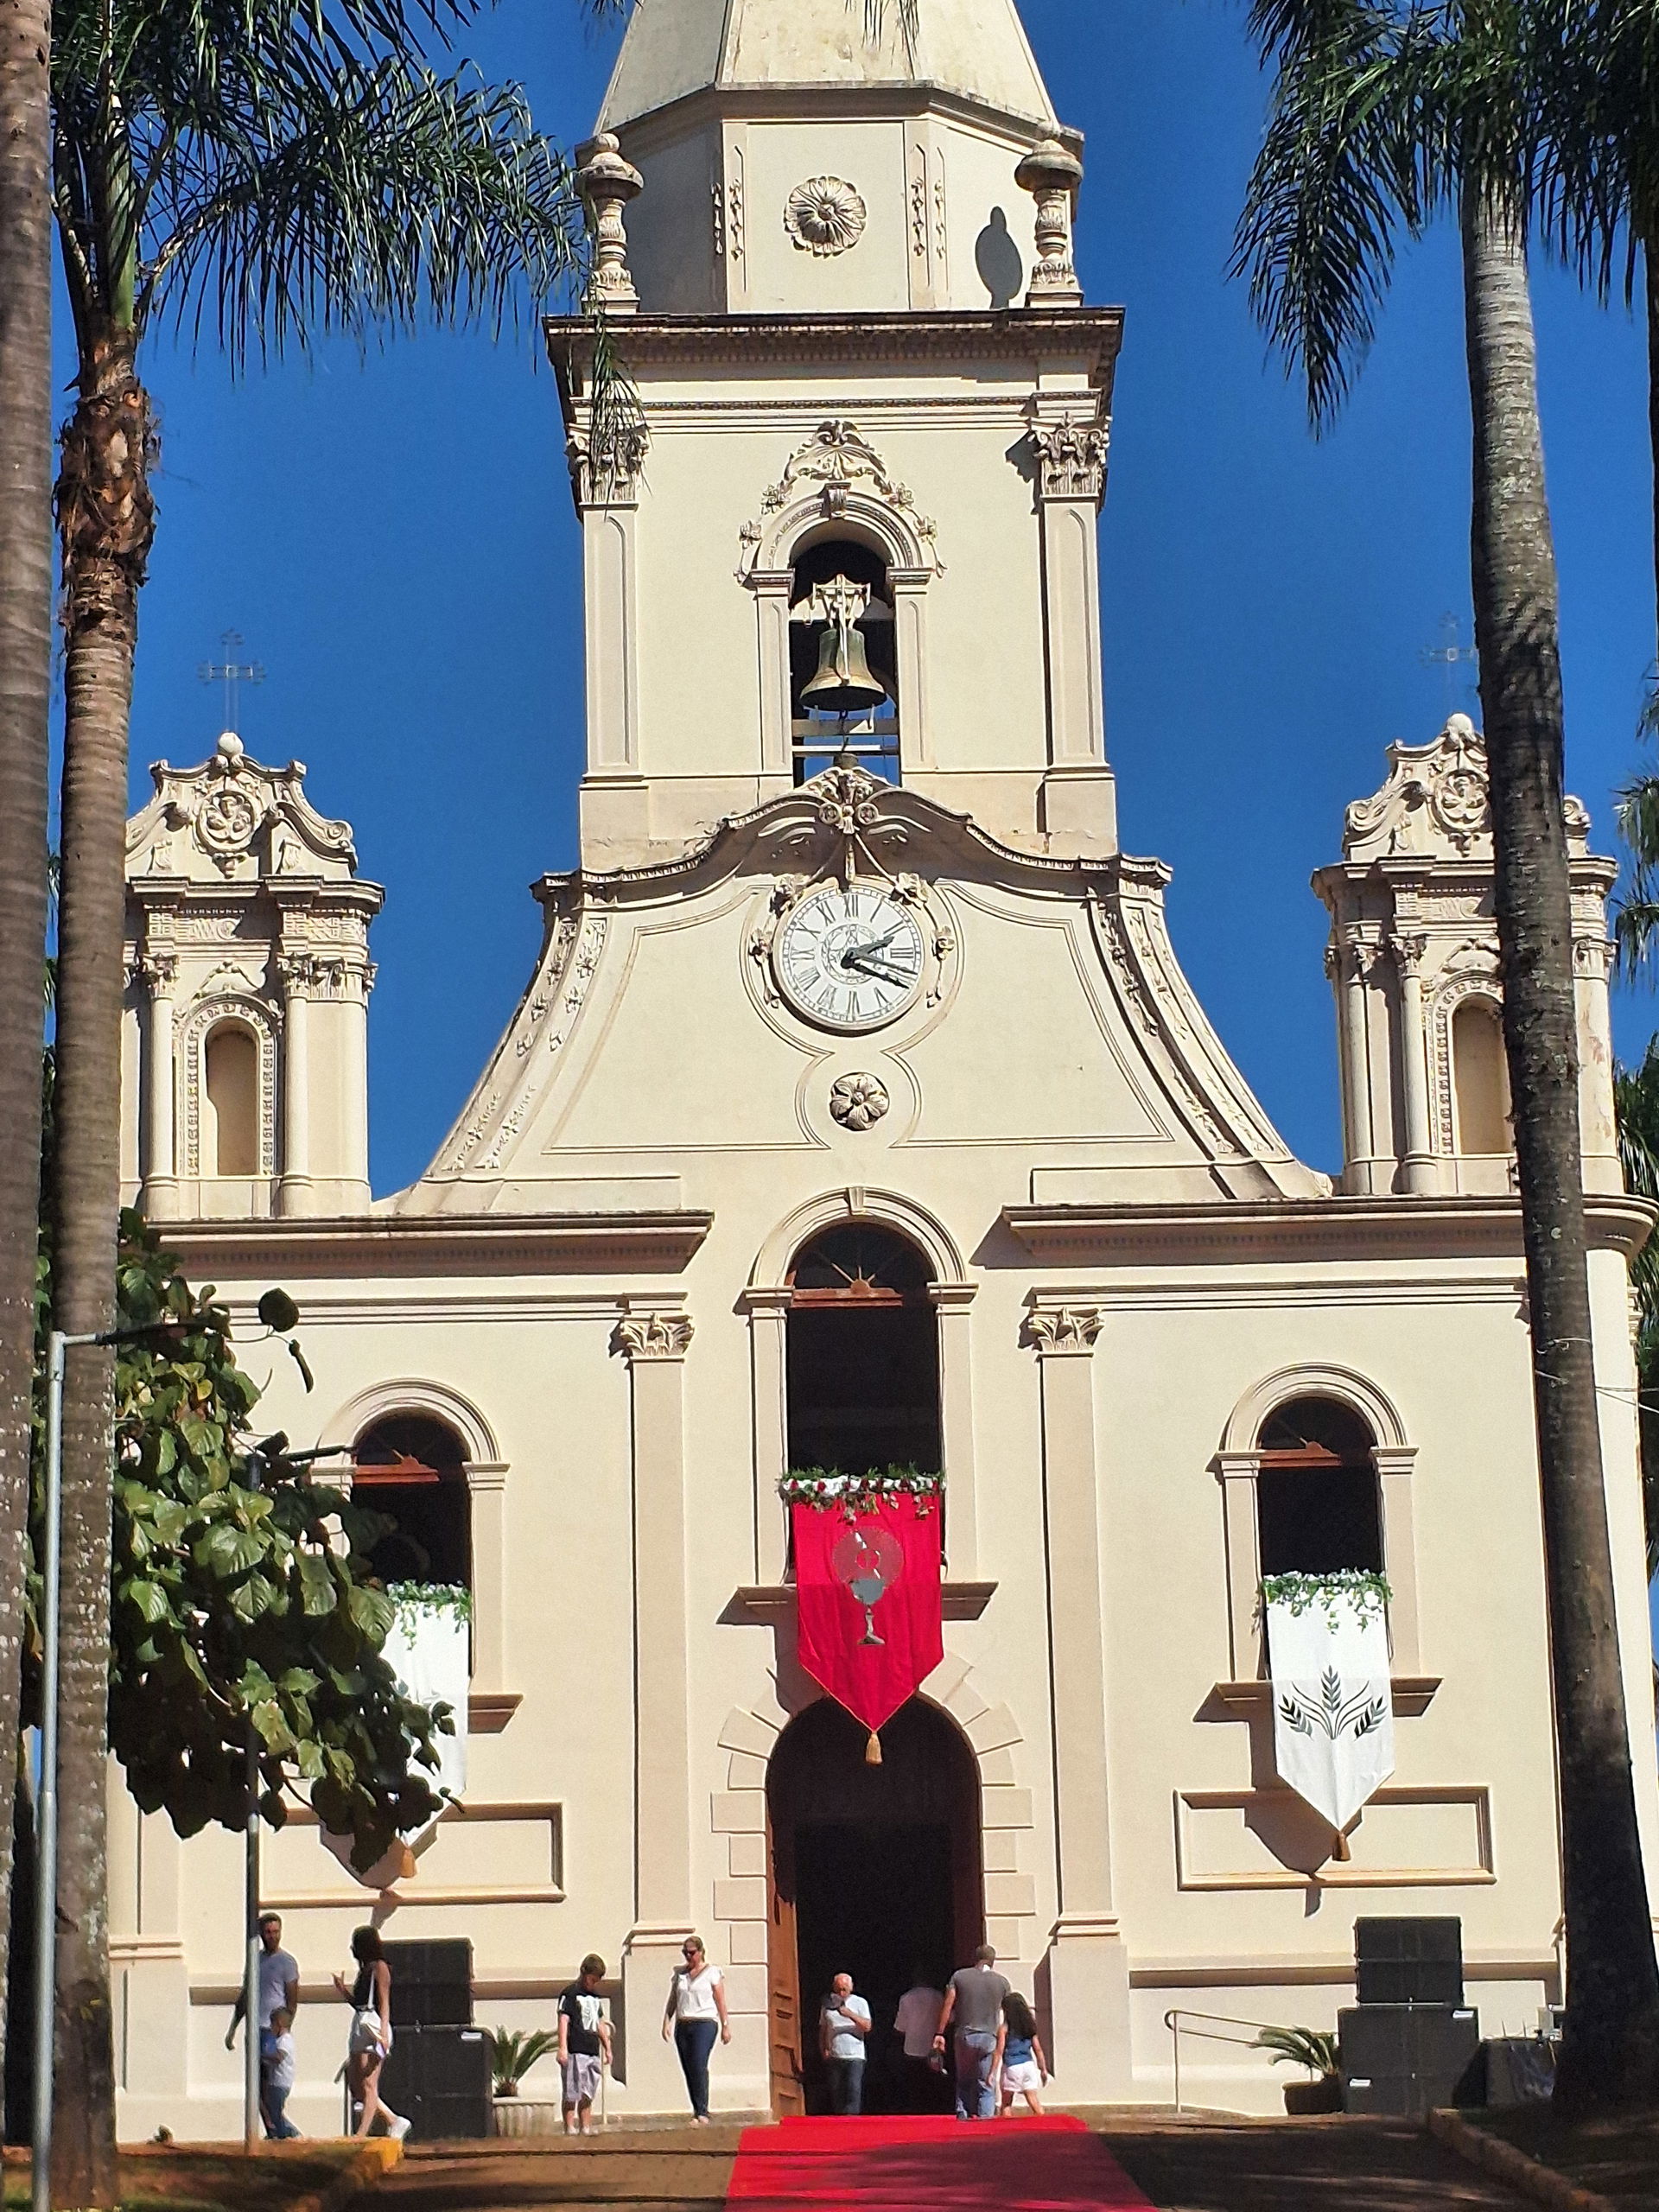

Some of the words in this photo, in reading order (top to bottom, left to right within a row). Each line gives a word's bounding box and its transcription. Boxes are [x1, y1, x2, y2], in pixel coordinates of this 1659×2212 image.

[816, 900, 836, 926] XI
[843, 894, 859, 918] XII
[795, 921, 821, 940] X
[890, 947, 914, 958] III
